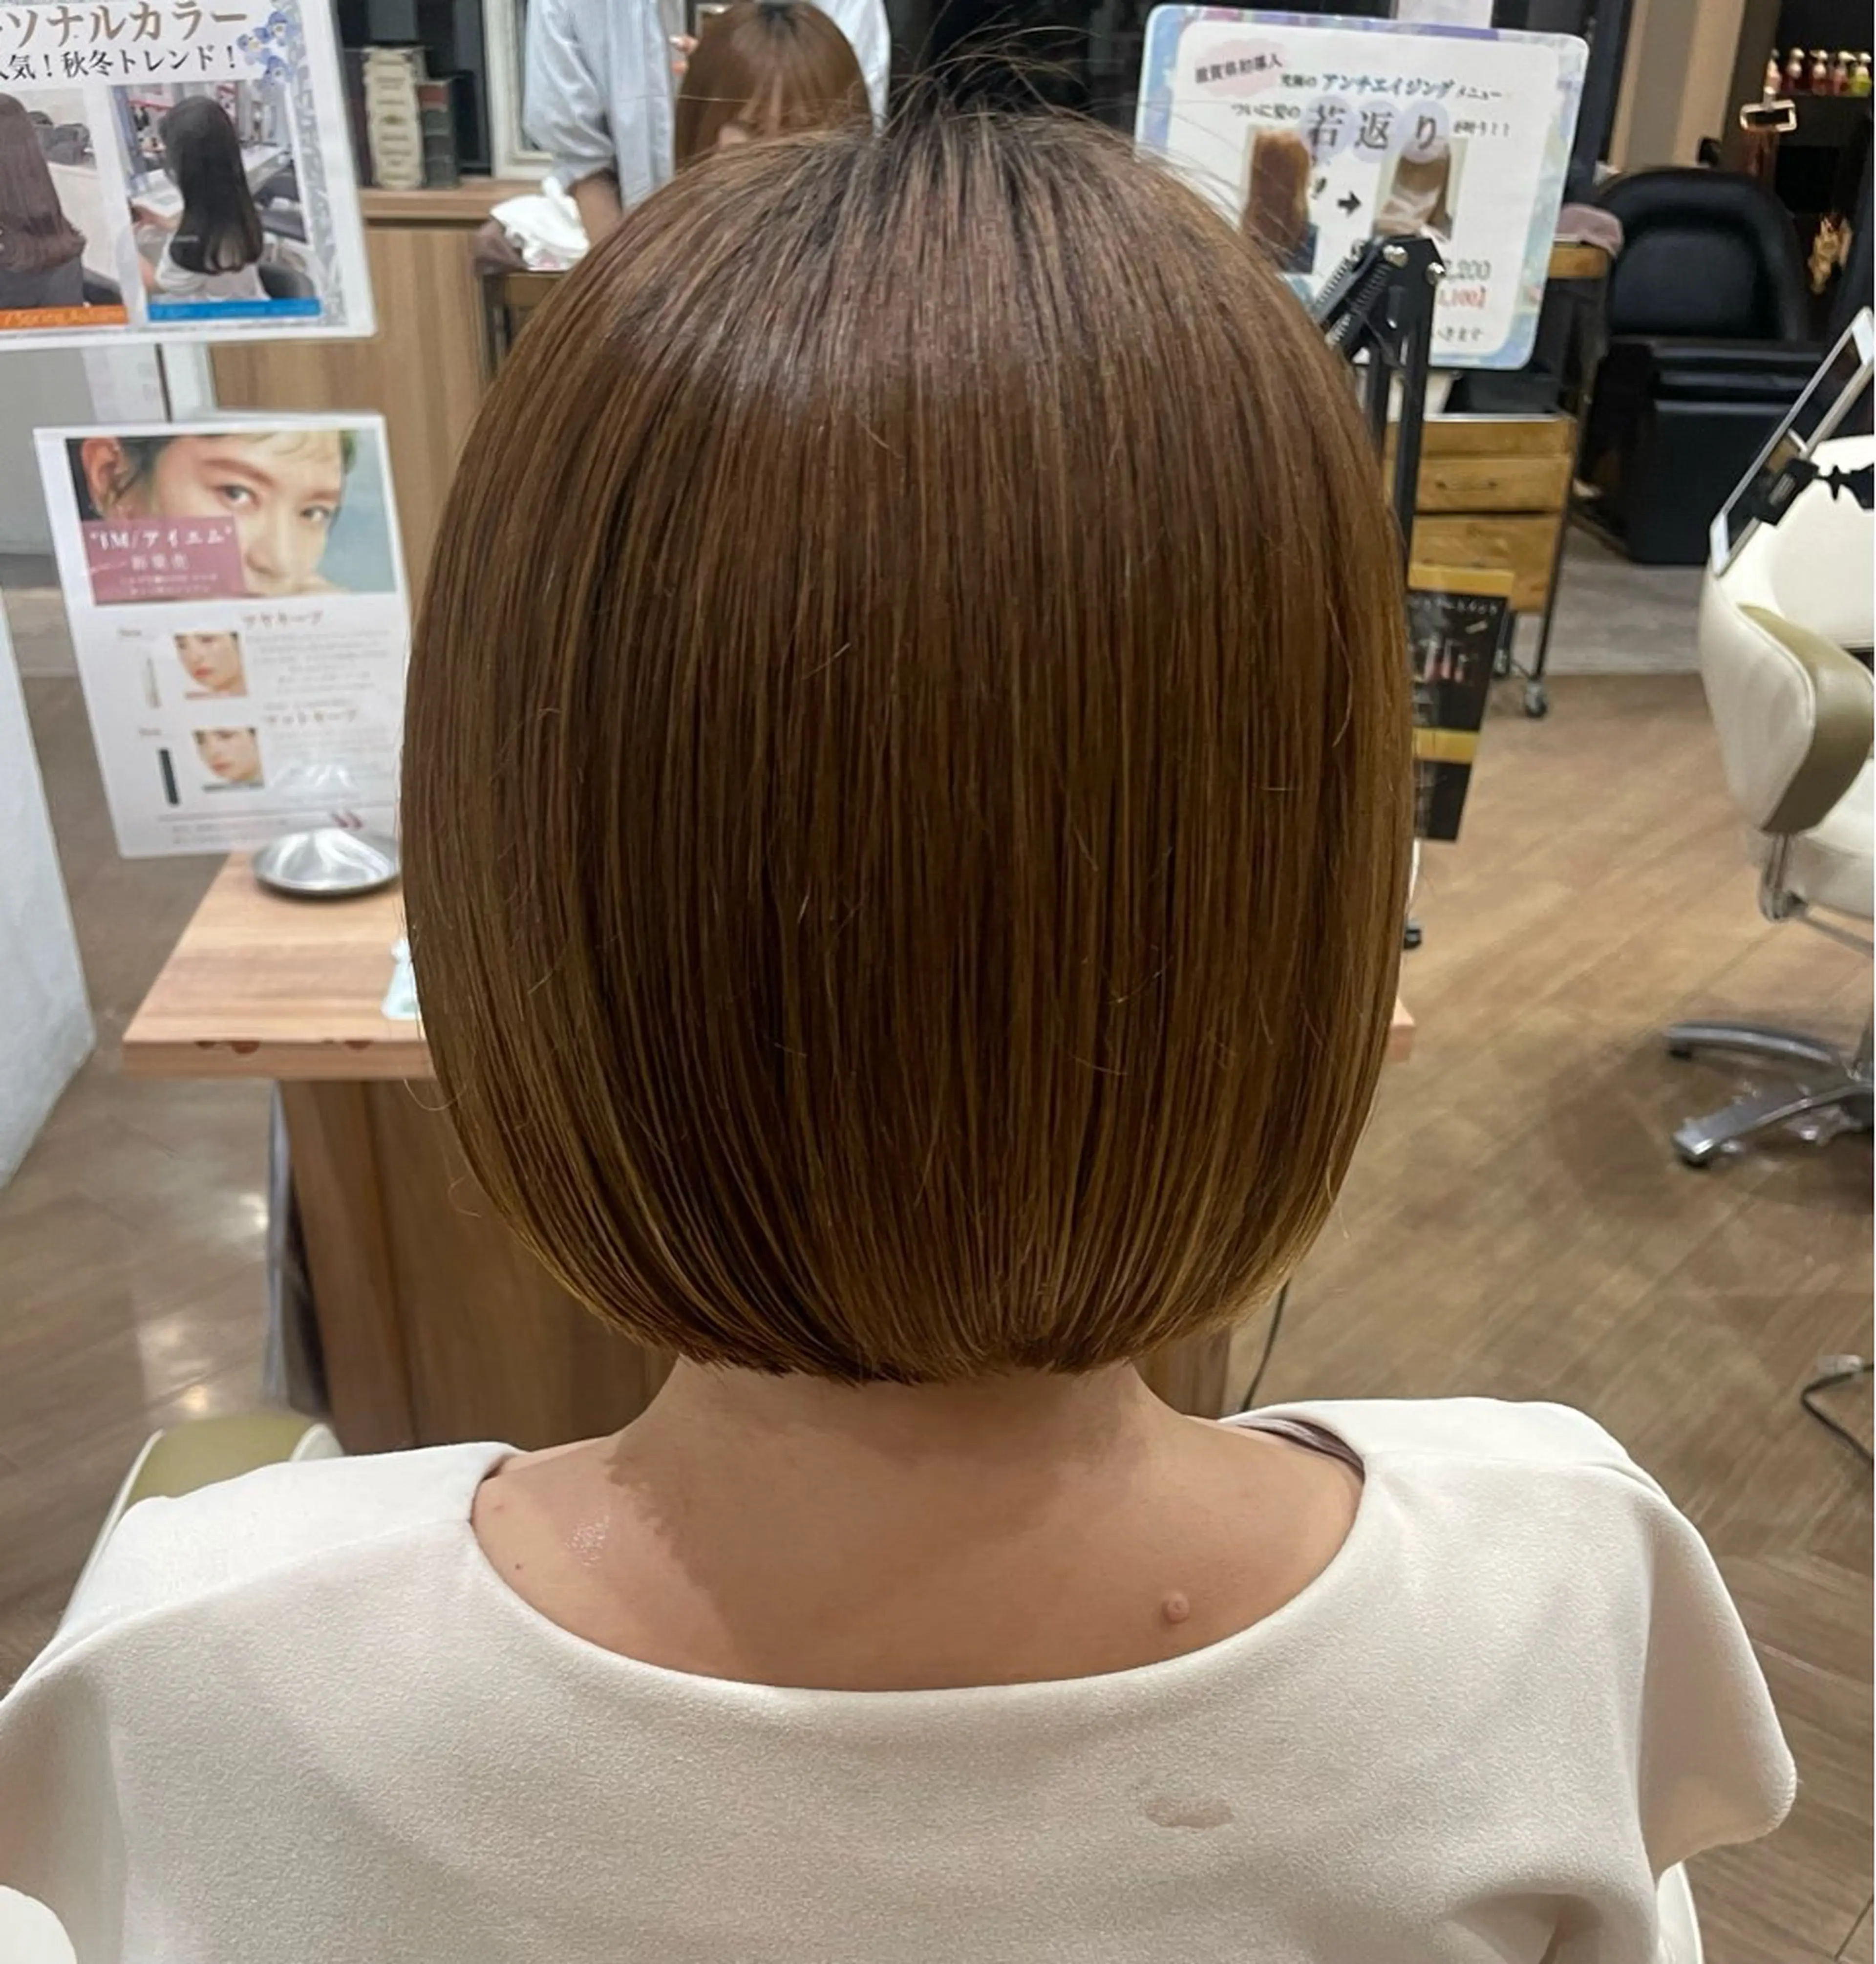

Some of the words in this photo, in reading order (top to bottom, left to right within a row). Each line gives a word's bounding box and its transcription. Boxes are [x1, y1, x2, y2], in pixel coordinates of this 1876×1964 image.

[0, 1, 247, 48] ソナルカラー
